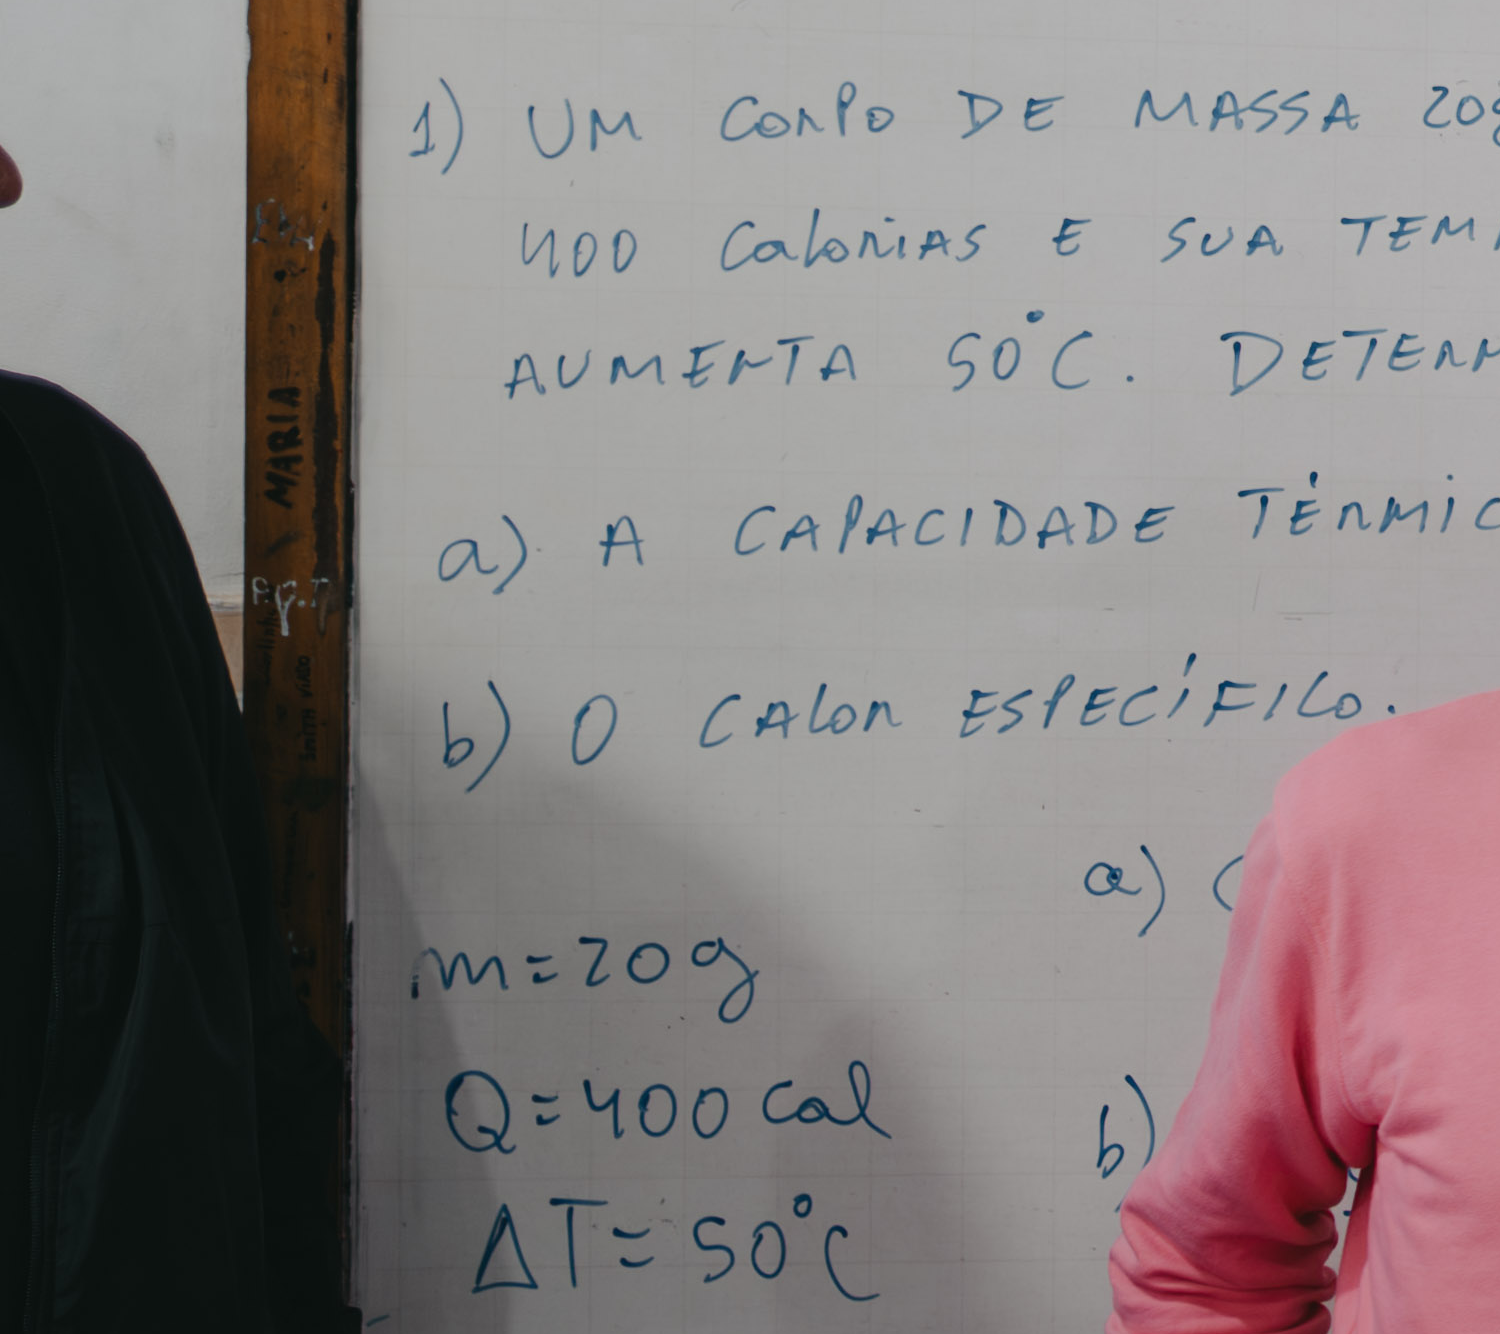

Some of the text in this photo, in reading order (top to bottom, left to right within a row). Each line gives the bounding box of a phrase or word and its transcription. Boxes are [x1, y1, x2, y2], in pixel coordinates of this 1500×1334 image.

[527, 99, 643, 159] UM
[958, 89, 1065, 133] DE
[1134, 89, 1361, 136] MASSA
[522, 222, 639, 278] 400
[1053, 218, 1092, 258] E
[1160, 216, 1285, 263] SUA
[504, 336, 858, 399] AUMENTA
[264, 385, 303, 510] MARIA
[600, 514, 646, 567] A
[732, 493, 1176, 555] CAPACIDADE
